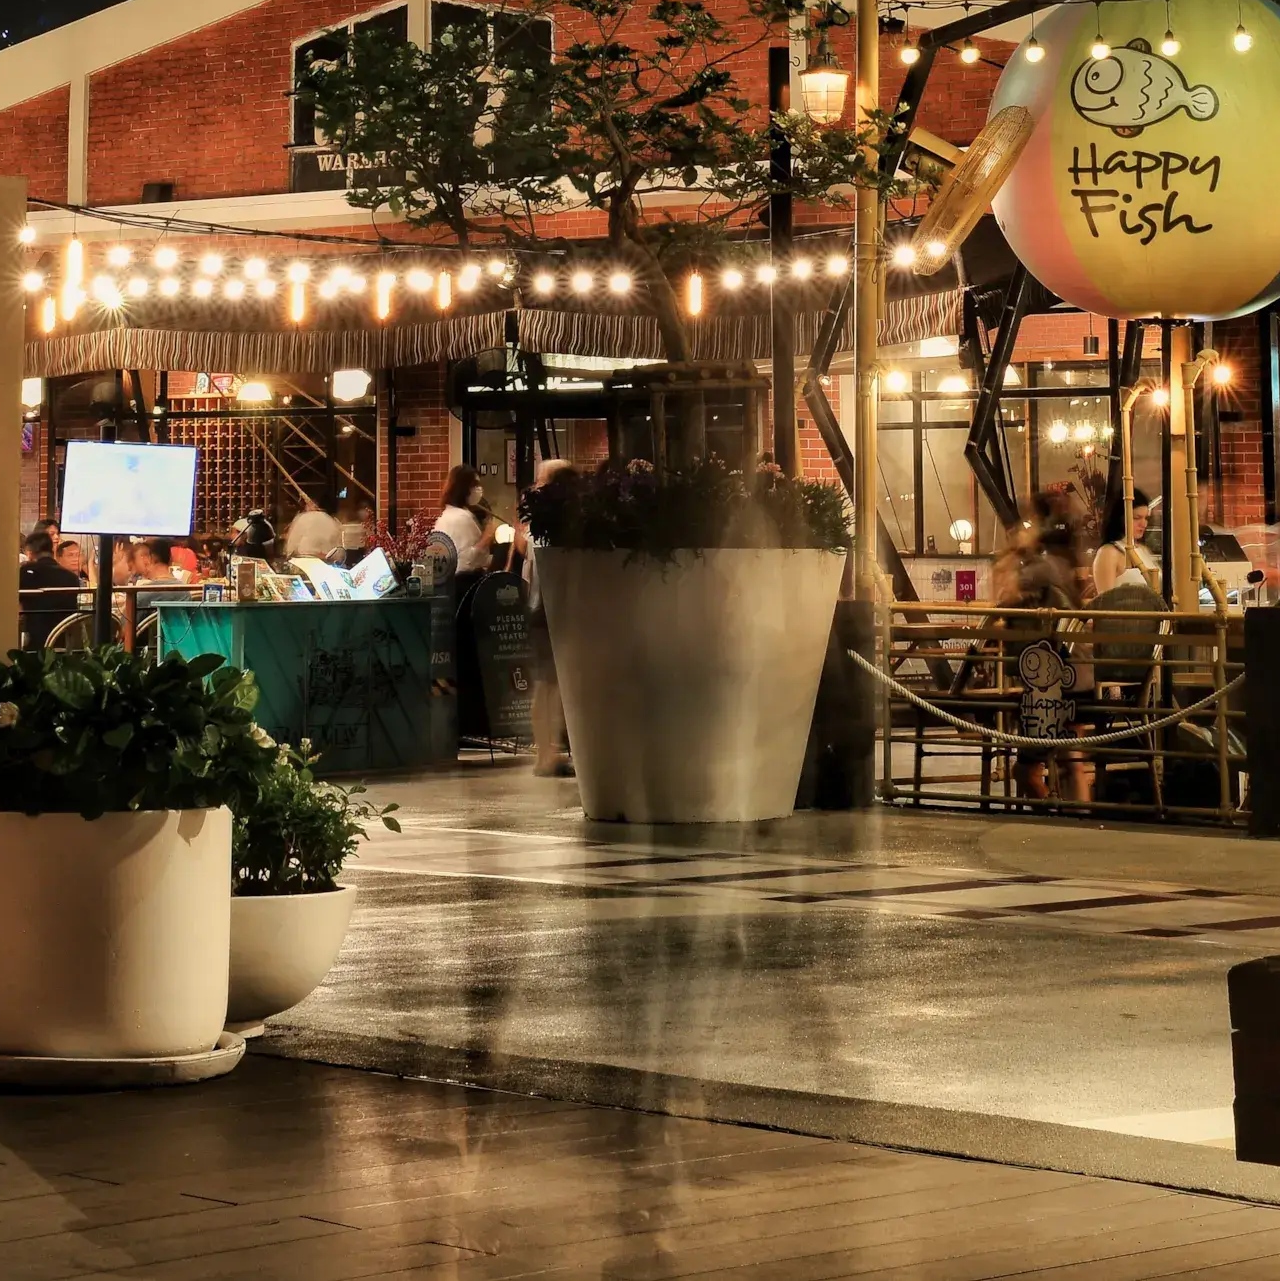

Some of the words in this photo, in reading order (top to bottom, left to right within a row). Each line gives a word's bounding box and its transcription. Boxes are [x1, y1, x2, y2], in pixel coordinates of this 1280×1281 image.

[1068, 142, 1221, 192] Happy
[1071, 190, 1213, 246] Fish
[489, 623, 509, 632] WAIT
[496, 615, 525, 623] PLEASE
[1021, 692, 1074, 719] Happy
[1021, 715, 1078, 739] Fish
